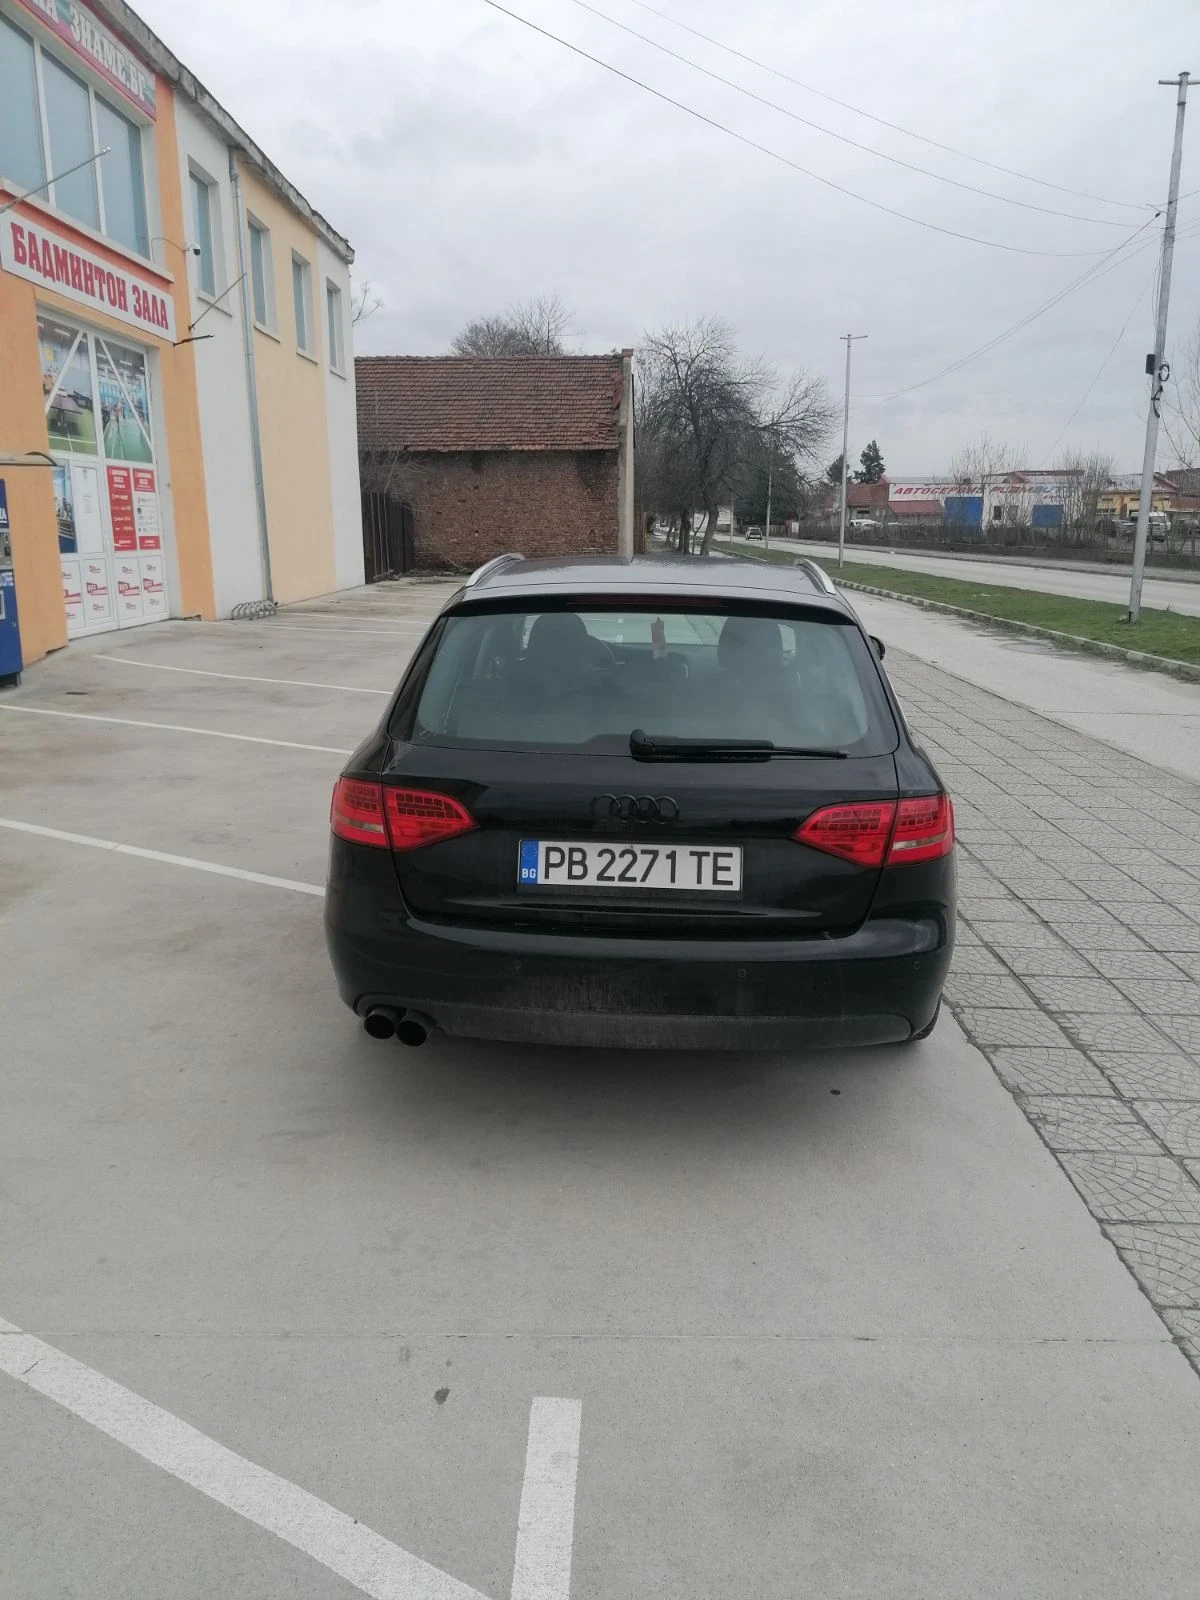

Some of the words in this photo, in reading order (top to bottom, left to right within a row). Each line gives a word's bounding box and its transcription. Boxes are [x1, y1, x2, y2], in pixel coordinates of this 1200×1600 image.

[11, 222, 128, 312] БАДМИНТОН
[131, 285, 169, 330] ЗАЛА
[521, 868, 537, 880] BG
[544, 846, 588, 881] PB
[596, 848, 678, 884] 2271
[689, 850, 734, 886] TE
